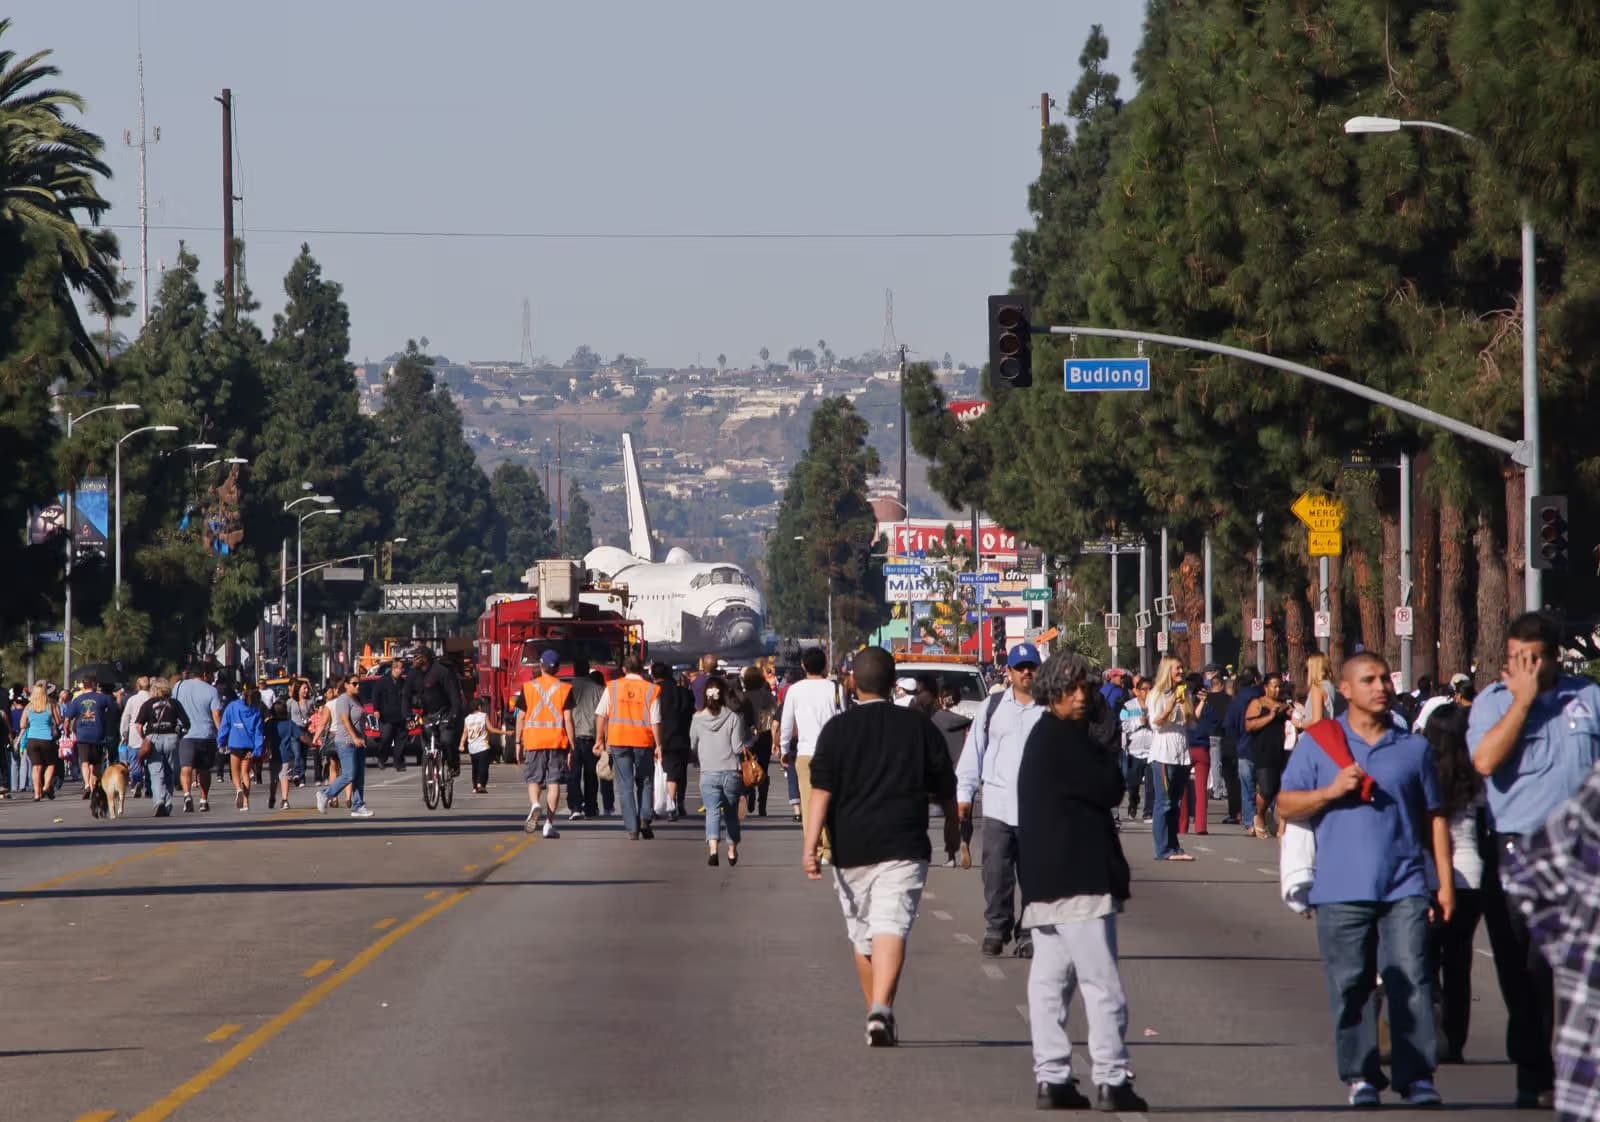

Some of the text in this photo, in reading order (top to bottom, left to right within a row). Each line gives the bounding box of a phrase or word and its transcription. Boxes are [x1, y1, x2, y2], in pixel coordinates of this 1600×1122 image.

[1069, 367, 1144, 388] Budlong
[1309, 509, 1341, 517] MERGE
[1314, 520, 1336, 528] LEFT
[889, 580, 951, 591] MARKE
